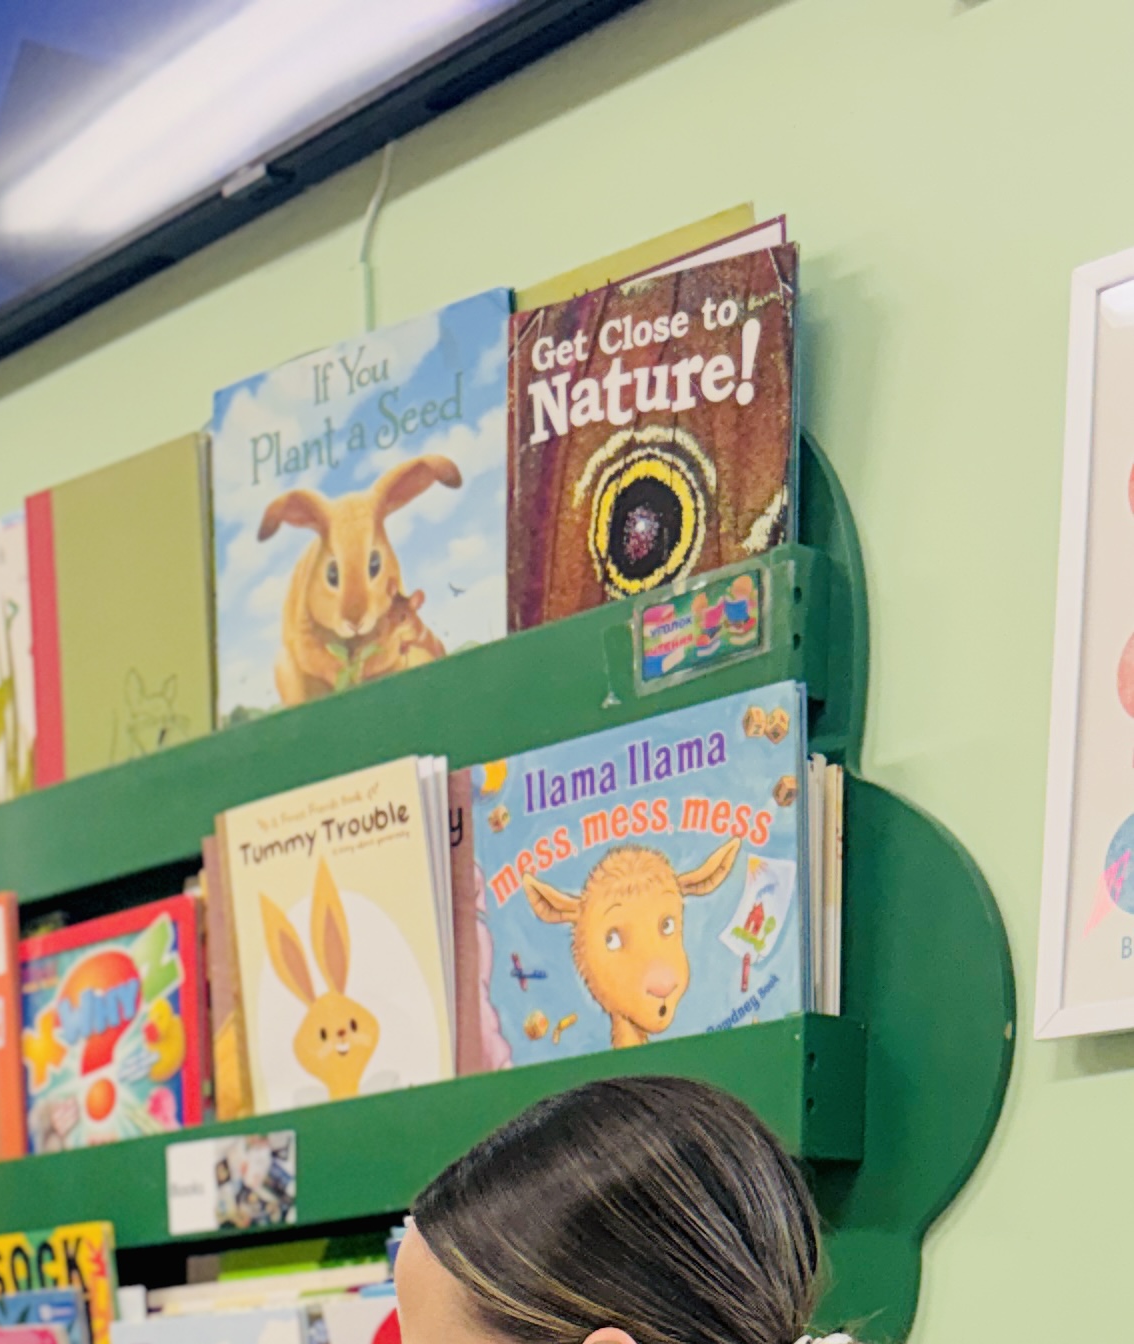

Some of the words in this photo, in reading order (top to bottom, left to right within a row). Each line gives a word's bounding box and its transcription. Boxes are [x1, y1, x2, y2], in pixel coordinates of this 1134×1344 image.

[531, 334, 588, 372] Get
[598, 307, 689, 354] Close
[701, 296, 738, 329] to
[313, 363, 331, 406] If
[340, 345, 390, 398] You
[527, 318, 762, 445] Nature!
[250, 417, 340, 485] Plant
[347, 426, 366, 453] a
[374, 370, 464, 450] Seed
[524, 758, 617, 814] llama
[626, 731, 727, 788] llama
[239, 828, 317, 867] Tummy
[320, 801, 411, 845] Trouble
[679, 795, 773, 848] mess
